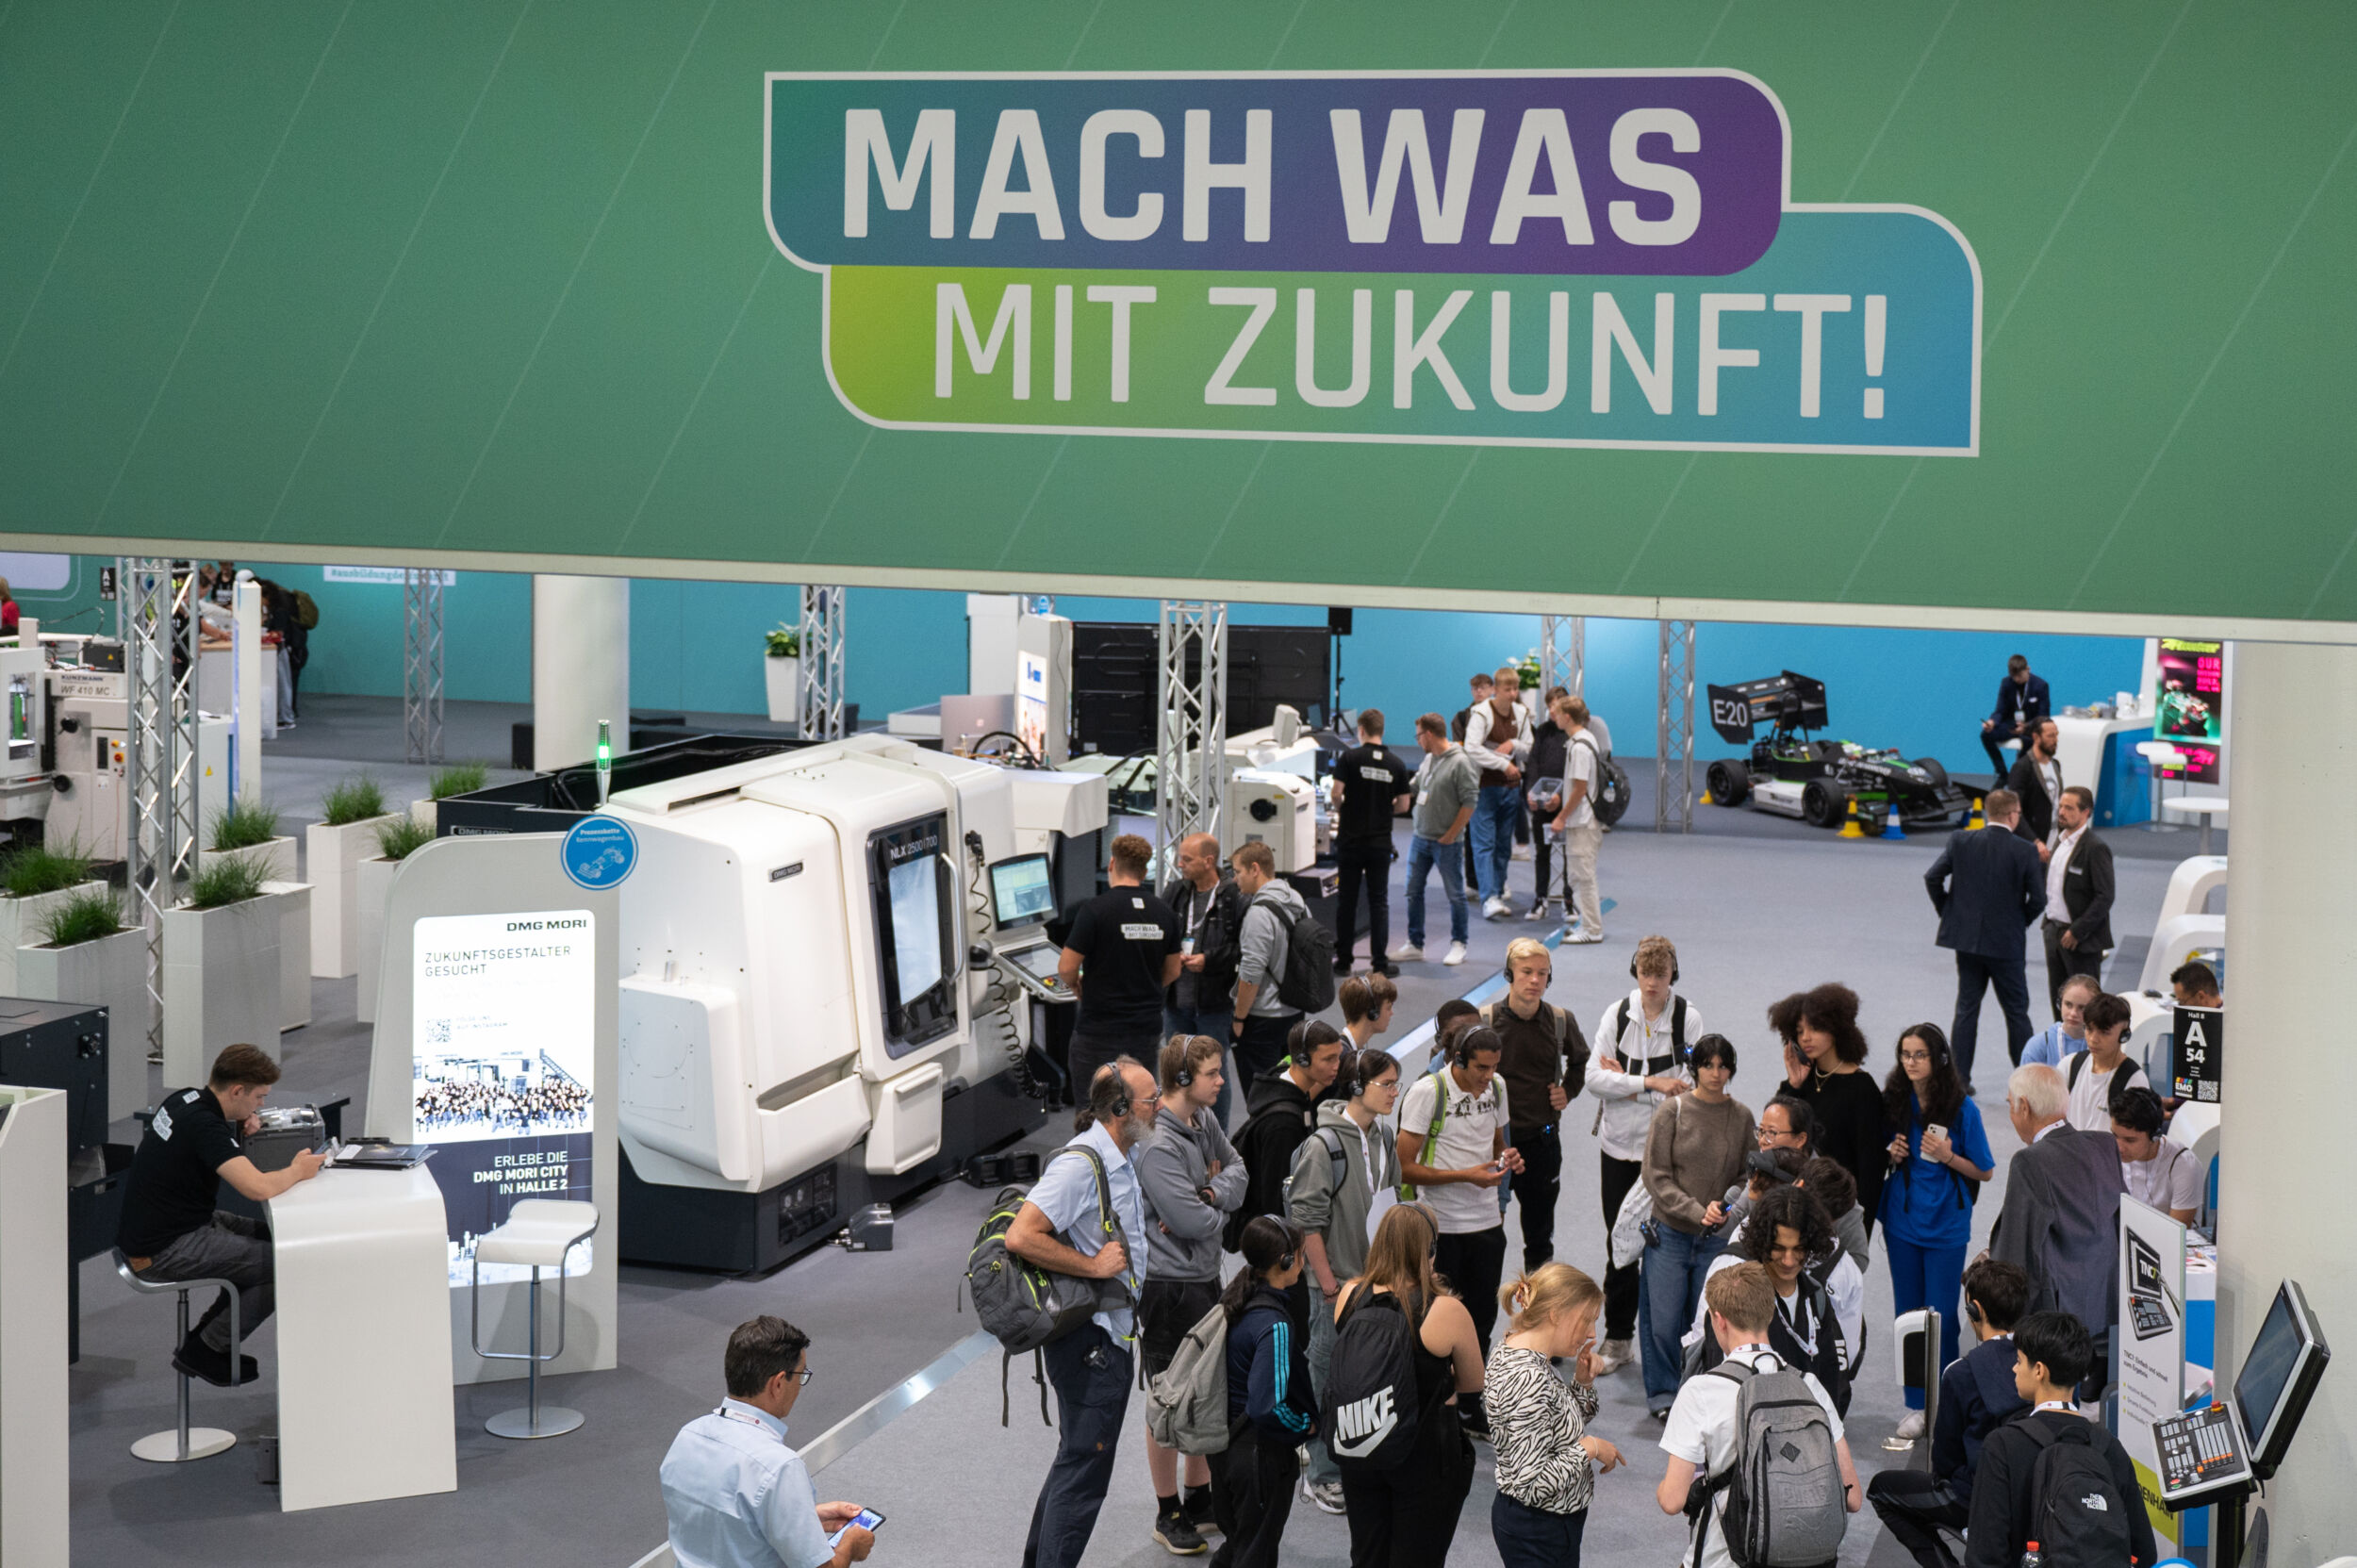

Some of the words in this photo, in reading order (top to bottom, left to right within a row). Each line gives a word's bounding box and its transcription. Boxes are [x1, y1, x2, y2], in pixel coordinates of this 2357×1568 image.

[844, 108, 1273, 242] MACH
[1329, 107, 1701, 245] WAS
[935, 283, 1157, 403] MIT
[1204, 287, 1887, 419] ZUKUNFT!
[60, 685, 74, 694] WF
[77, 686, 93, 695] 410
[96, 686, 109, 695] MC
[1713, 699, 1748, 727] E20
[890, 845, 906, 860] NLX
[506, 921, 543, 932] DMG
[547, 919, 586, 930] MORI
[425, 946, 571, 963] ZUKUNFTSGESTALTER
[425, 964, 486, 977] GESUCHT
[2184, 1020, 2207, 1047] A
[2185, 1048, 2205, 1064] 54
[2175, 1082, 2193, 1093] EMO
[495, 1152, 544, 1167] ERLEBE
[547, 1151, 568, 1164] DIE
[473, 1170, 503, 1183] DMG
[505, 1166, 537, 1180] MORI
[540, 1164, 569, 1178] CITY
[500, 1182, 513, 1195] IN
[516, 1180, 558, 1194] HALLE
[560, 1179, 568, 1190] 2
[2139, 1259, 2156, 1279] TNC7
[1337, 1384, 1394, 1442] NIKE
